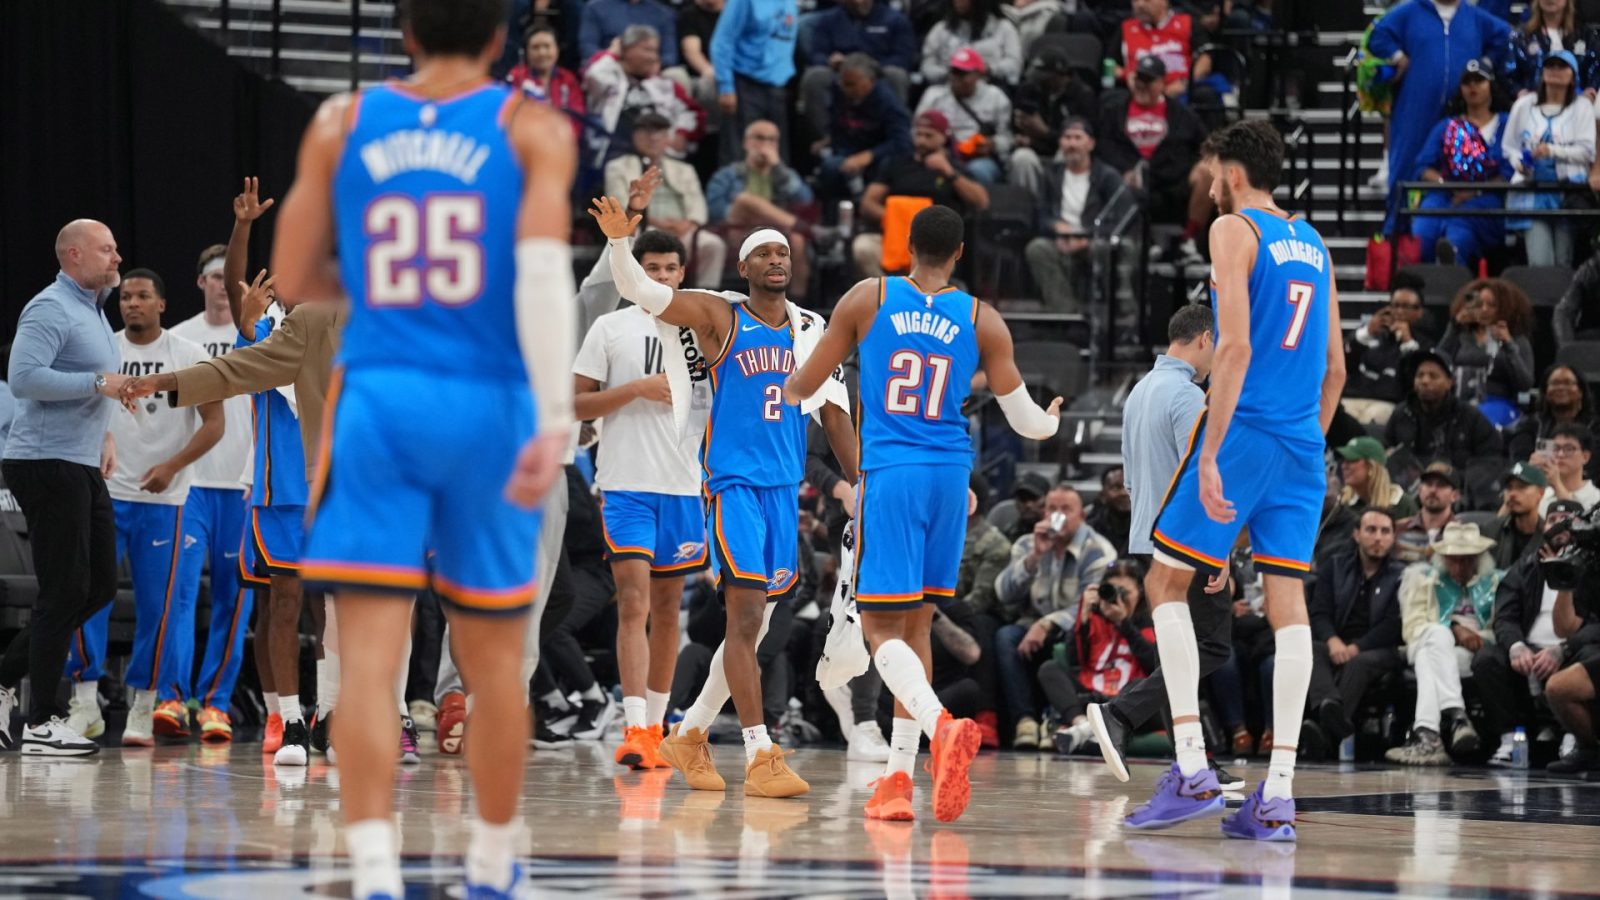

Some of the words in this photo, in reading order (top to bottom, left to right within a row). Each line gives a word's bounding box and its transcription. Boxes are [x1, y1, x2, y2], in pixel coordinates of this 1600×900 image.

[361, 129, 490, 184] MITCHELL
[365, 192, 486, 308] 25
[1268, 240, 1324, 273] HOLMGREN
[890, 311, 960, 344] WIGGINS
[1282, 281, 1315, 350] 7
[735, 346, 797, 376] THUND
[763, 384, 783, 420] 2
[885, 349, 952, 420] 21
